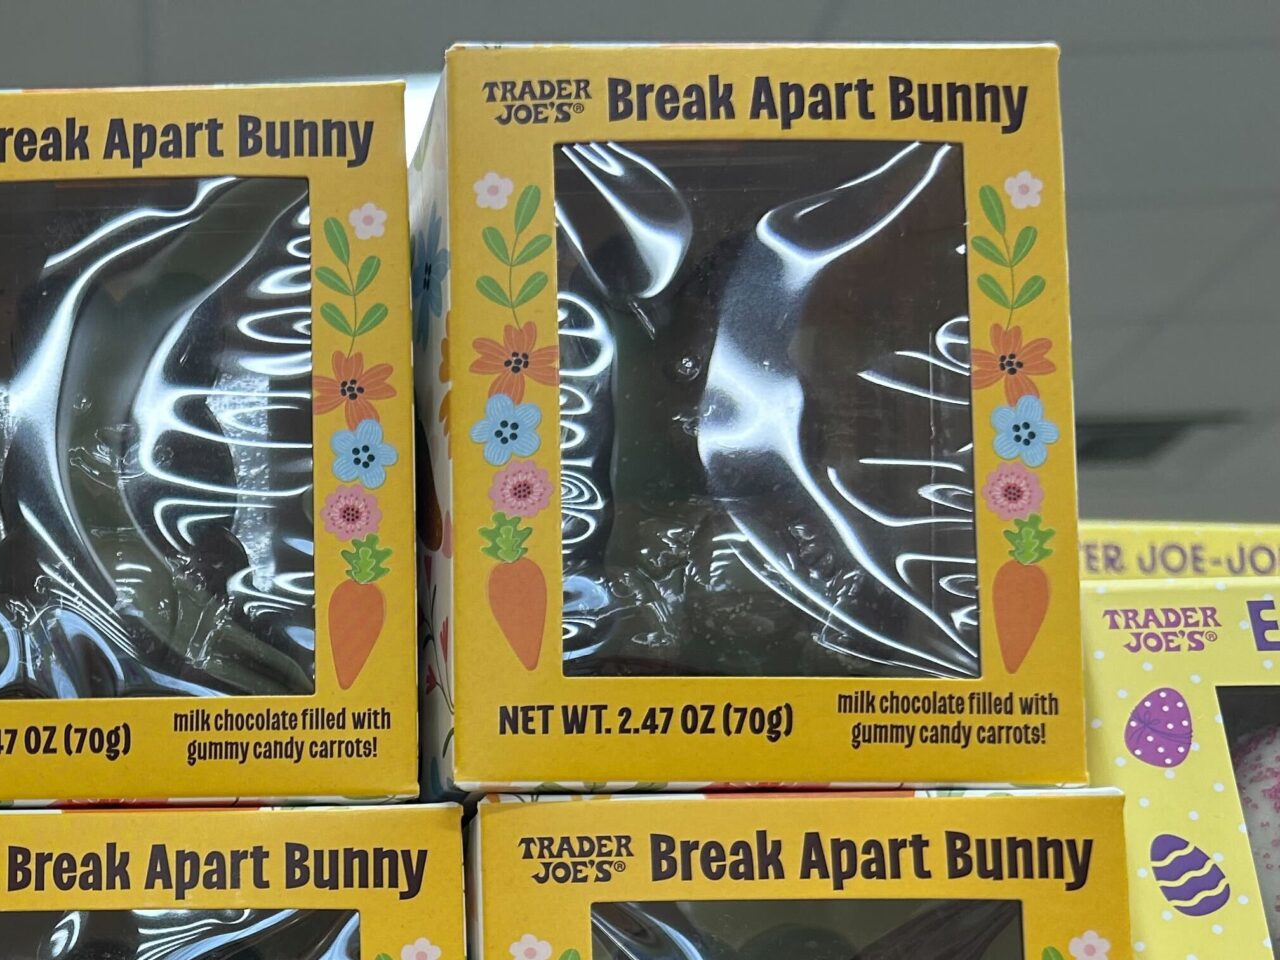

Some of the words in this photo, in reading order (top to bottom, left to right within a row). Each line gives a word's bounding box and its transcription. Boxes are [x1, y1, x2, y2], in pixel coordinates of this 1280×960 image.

[482, 79, 592, 102] TRADER
[608, 74, 735, 122] Break
[750, 76, 875, 130] Apart
[889, 76, 1028, 134] Bunny
[103, 118, 224, 168] Apart
[239, 115, 374, 168] Bunny
[1103, 607, 1221, 629] TRADER
[838, 691, 875, 713] milk
[880, 691, 964, 714] chocolate
[968, 692, 1013, 715] filled
[1019, 693, 1058, 715] with
[174, 709, 210, 731] milk
[214, 708, 297, 731] chocolate
[301, 707, 346, 730] filled
[352, 707, 390, 729] with
[500, 705, 554, 735] NET
[562, 705, 611, 734] WT.
[618, 707, 673, 734] 2.47
[681, 705, 715, 734] OZ
[723, 703, 793, 742] (70g)
[25, 726, 57, 754] OZ
[64, 723, 130, 761] (70g)
[852, 722, 916, 749] gummy
[920, 721, 972, 749] candy
[977, 723, 1046, 744] carrots!
[188, 740, 249, 766] gummy
[253, 736, 304, 763] candy
[309, 737, 377, 758] carrots!
[518, 835, 634, 859] TRADER
[650, 830, 785, 881] Break
[800, 832, 932, 890] Apart
[945, 831, 1093, 891] Bunny
[8, 842, 130, 891] Break
[144, 844, 270, 900] Apart
[285, 842, 428, 900] Bunny
